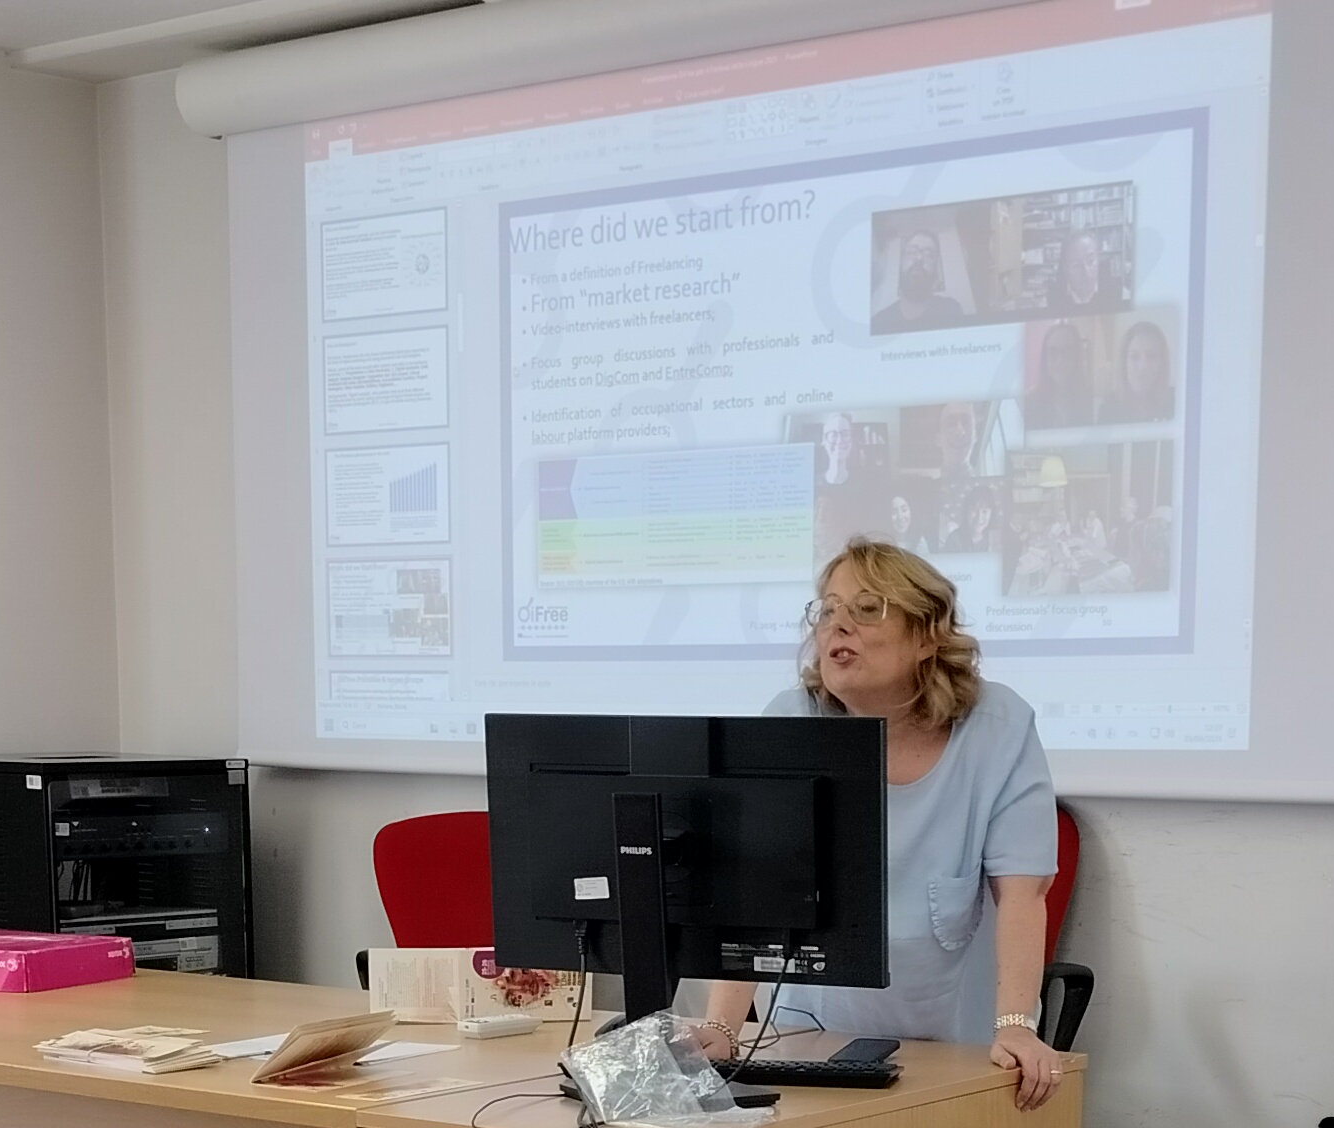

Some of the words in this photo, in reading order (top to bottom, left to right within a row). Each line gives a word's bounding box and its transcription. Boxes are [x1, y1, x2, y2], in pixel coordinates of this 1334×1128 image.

[509, 225, 584, 254] Where
[591, 212, 628, 245] did
[634, 217, 668, 240] we
[676, 202, 733, 236] start
[741, 190, 816, 227] from?
[530, 271, 559, 286] From
[561, 271, 568, 283] a
[569, 265, 622, 282] definition
[624, 261, 636, 276] of
[638, 256, 703, 274] Freelancing
[531, 292, 575, 313] From
[531, 316, 621, 336] Video-interviews
[623, 313, 647, 327] with
[649, 307, 716, 325] freelancers;
[531, 356, 562, 370] Focus
[572, 352, 603, 369] group
[614, 345, 676, 363] discussions
[687, 342, 712, 356] with
[723, 334, 800, 356] professionals
[811, 330, 834, 345] and
[880, 349, 927, 362] Interviews
[928, 347, 949, 359] with
[950, 342, 1002, 357] freelancers
[531, 373, 577, 390] students
[579, 375, 593, 387] on
[595, 369, 640, 387] DigCom
[641, 367, 663, 382] and
[531, 406, 602, 423] Identification
[611, 404, 622, 418] of
[631, 398, 703, 418] occupational
[712, 395, 754, 411] sectors
[764, 392, 787, 406] and
[796, 389, 834, 404] online
[531, 429, 565, 445] labour
[568, 426, 614, 444] platform
[616, 422, 671, 440] providers;
[1051, 604, 1078, 615] focus
[1079, 604, 1108, 617] group
[985, 621, 1033, 633] discussion
[620, 846, 652, 855] PHILIPS
